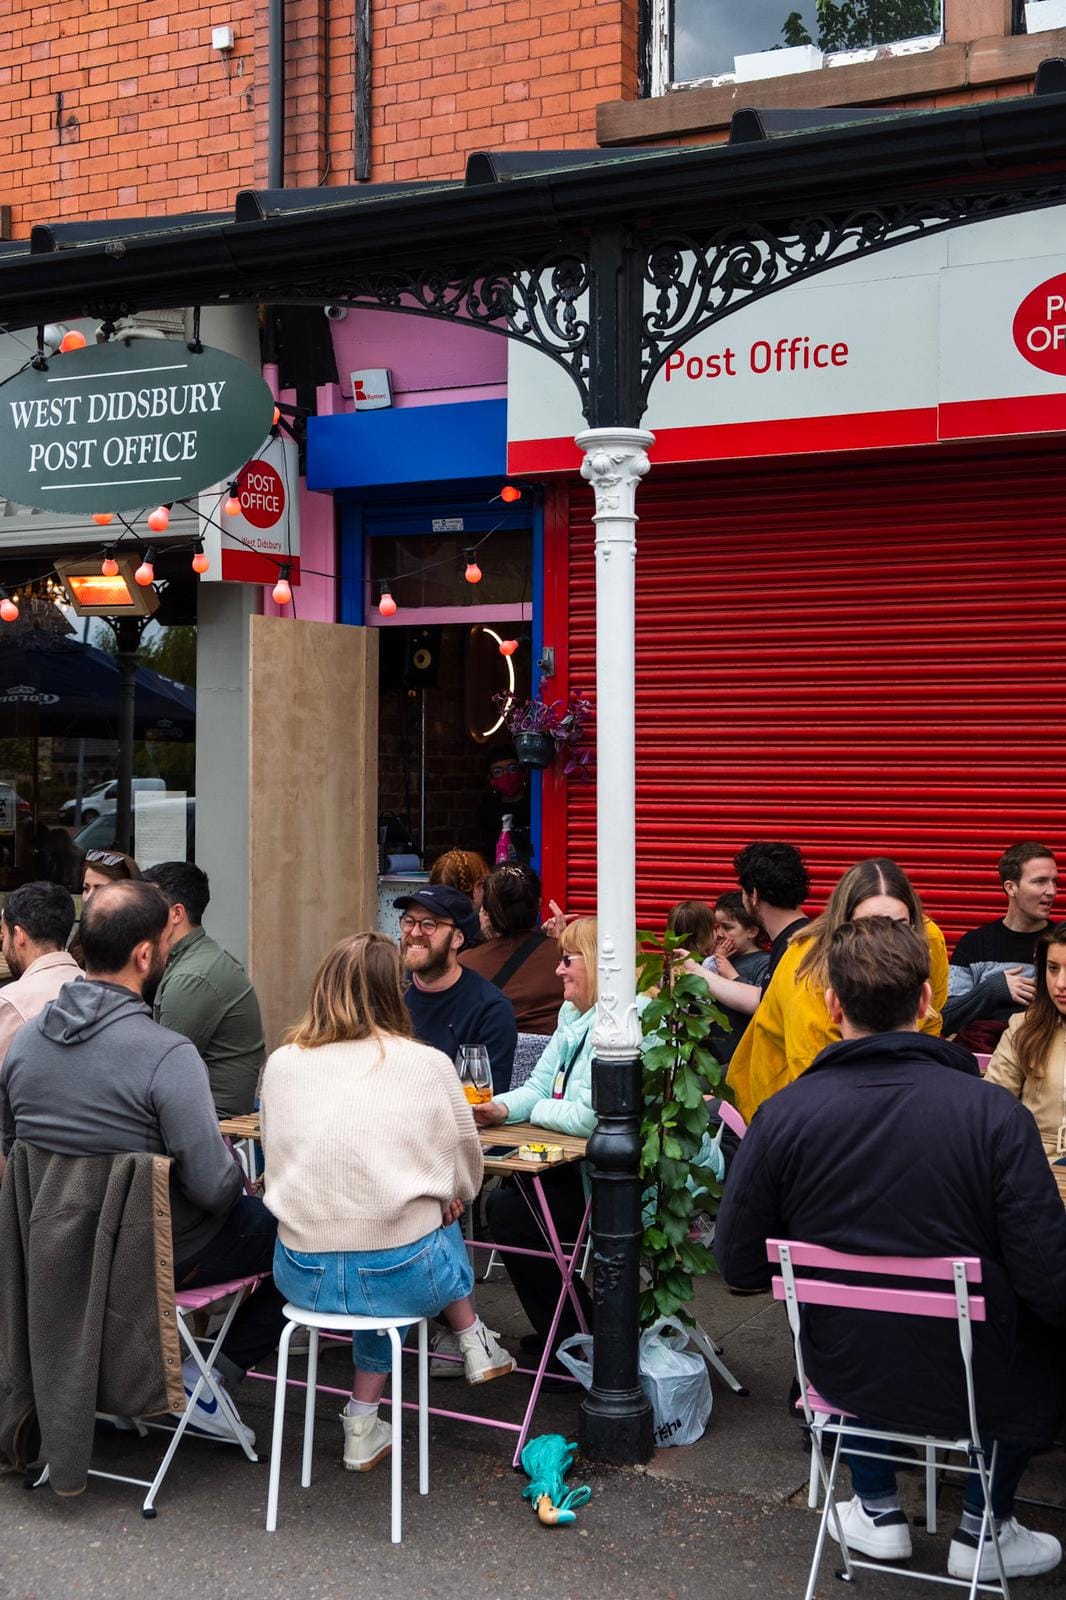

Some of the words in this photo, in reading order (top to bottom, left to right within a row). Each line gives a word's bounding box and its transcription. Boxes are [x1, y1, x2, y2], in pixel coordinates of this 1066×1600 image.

[664, 348, 737, 382] Post
[749, 336, 849, 375] Office
[9, 395, 82, 430] WEST
[88, 380, 226, 424] DIDSBURY
[28, 439, 98, 473] POST
[102, 430, 198, 467] OFFICE
[247, 473, 275, 492] POST
[240, 491, 279, 512] OFFICE
[241, 537, 256, 547] West
[257, 538, 282, 552] Didsbury
